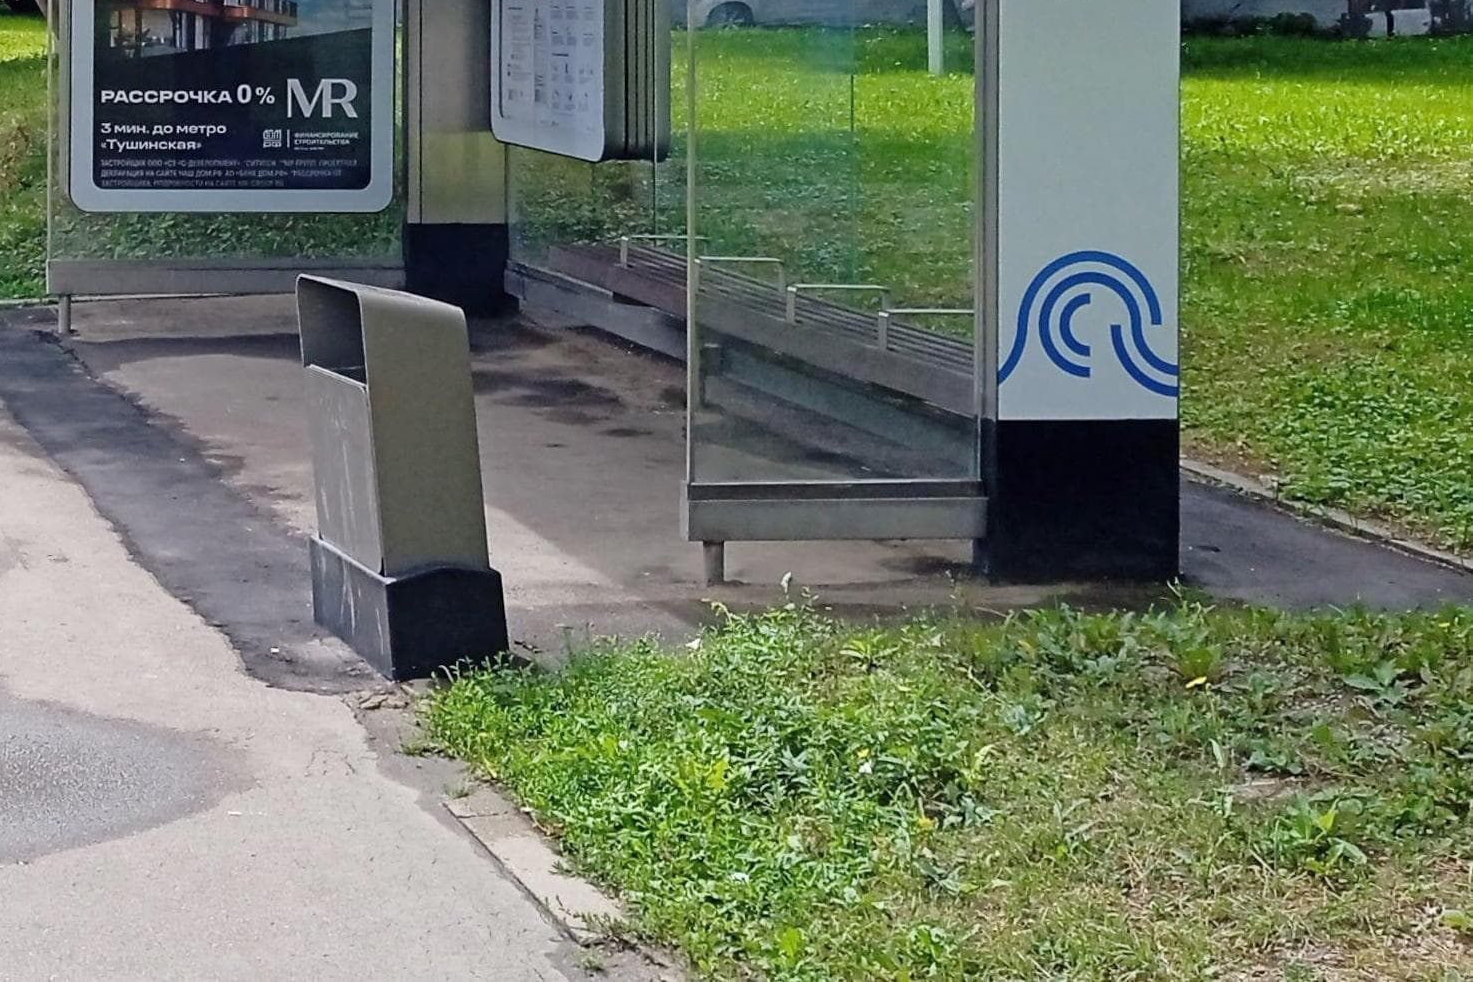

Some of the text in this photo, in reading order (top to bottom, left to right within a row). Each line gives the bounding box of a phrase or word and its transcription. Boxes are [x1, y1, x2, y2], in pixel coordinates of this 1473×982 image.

[100, 90, 233, 104] РАССРОЧКА
[286, 78, 359, 118] MR
[100, 123, 227, 138] 3 мин. до метро
[100, 139, 203, 153] «Тушинская»
